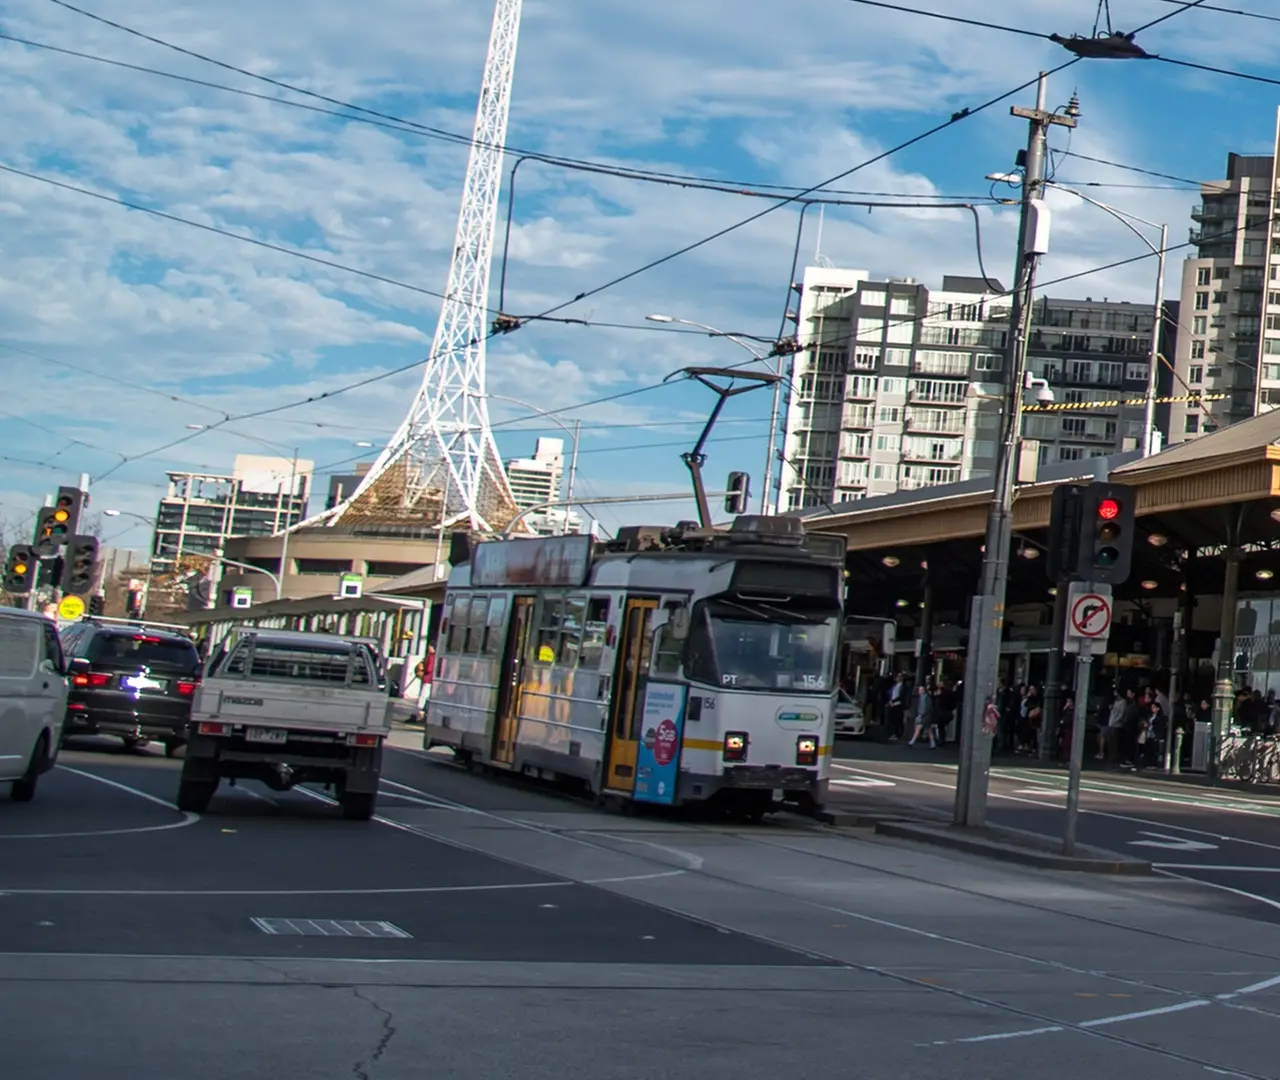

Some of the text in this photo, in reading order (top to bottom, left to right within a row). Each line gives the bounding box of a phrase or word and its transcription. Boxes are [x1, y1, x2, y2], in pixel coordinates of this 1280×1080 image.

[723, 675, 825, 689] PT 156
[704, 697, 716, 710] 156
